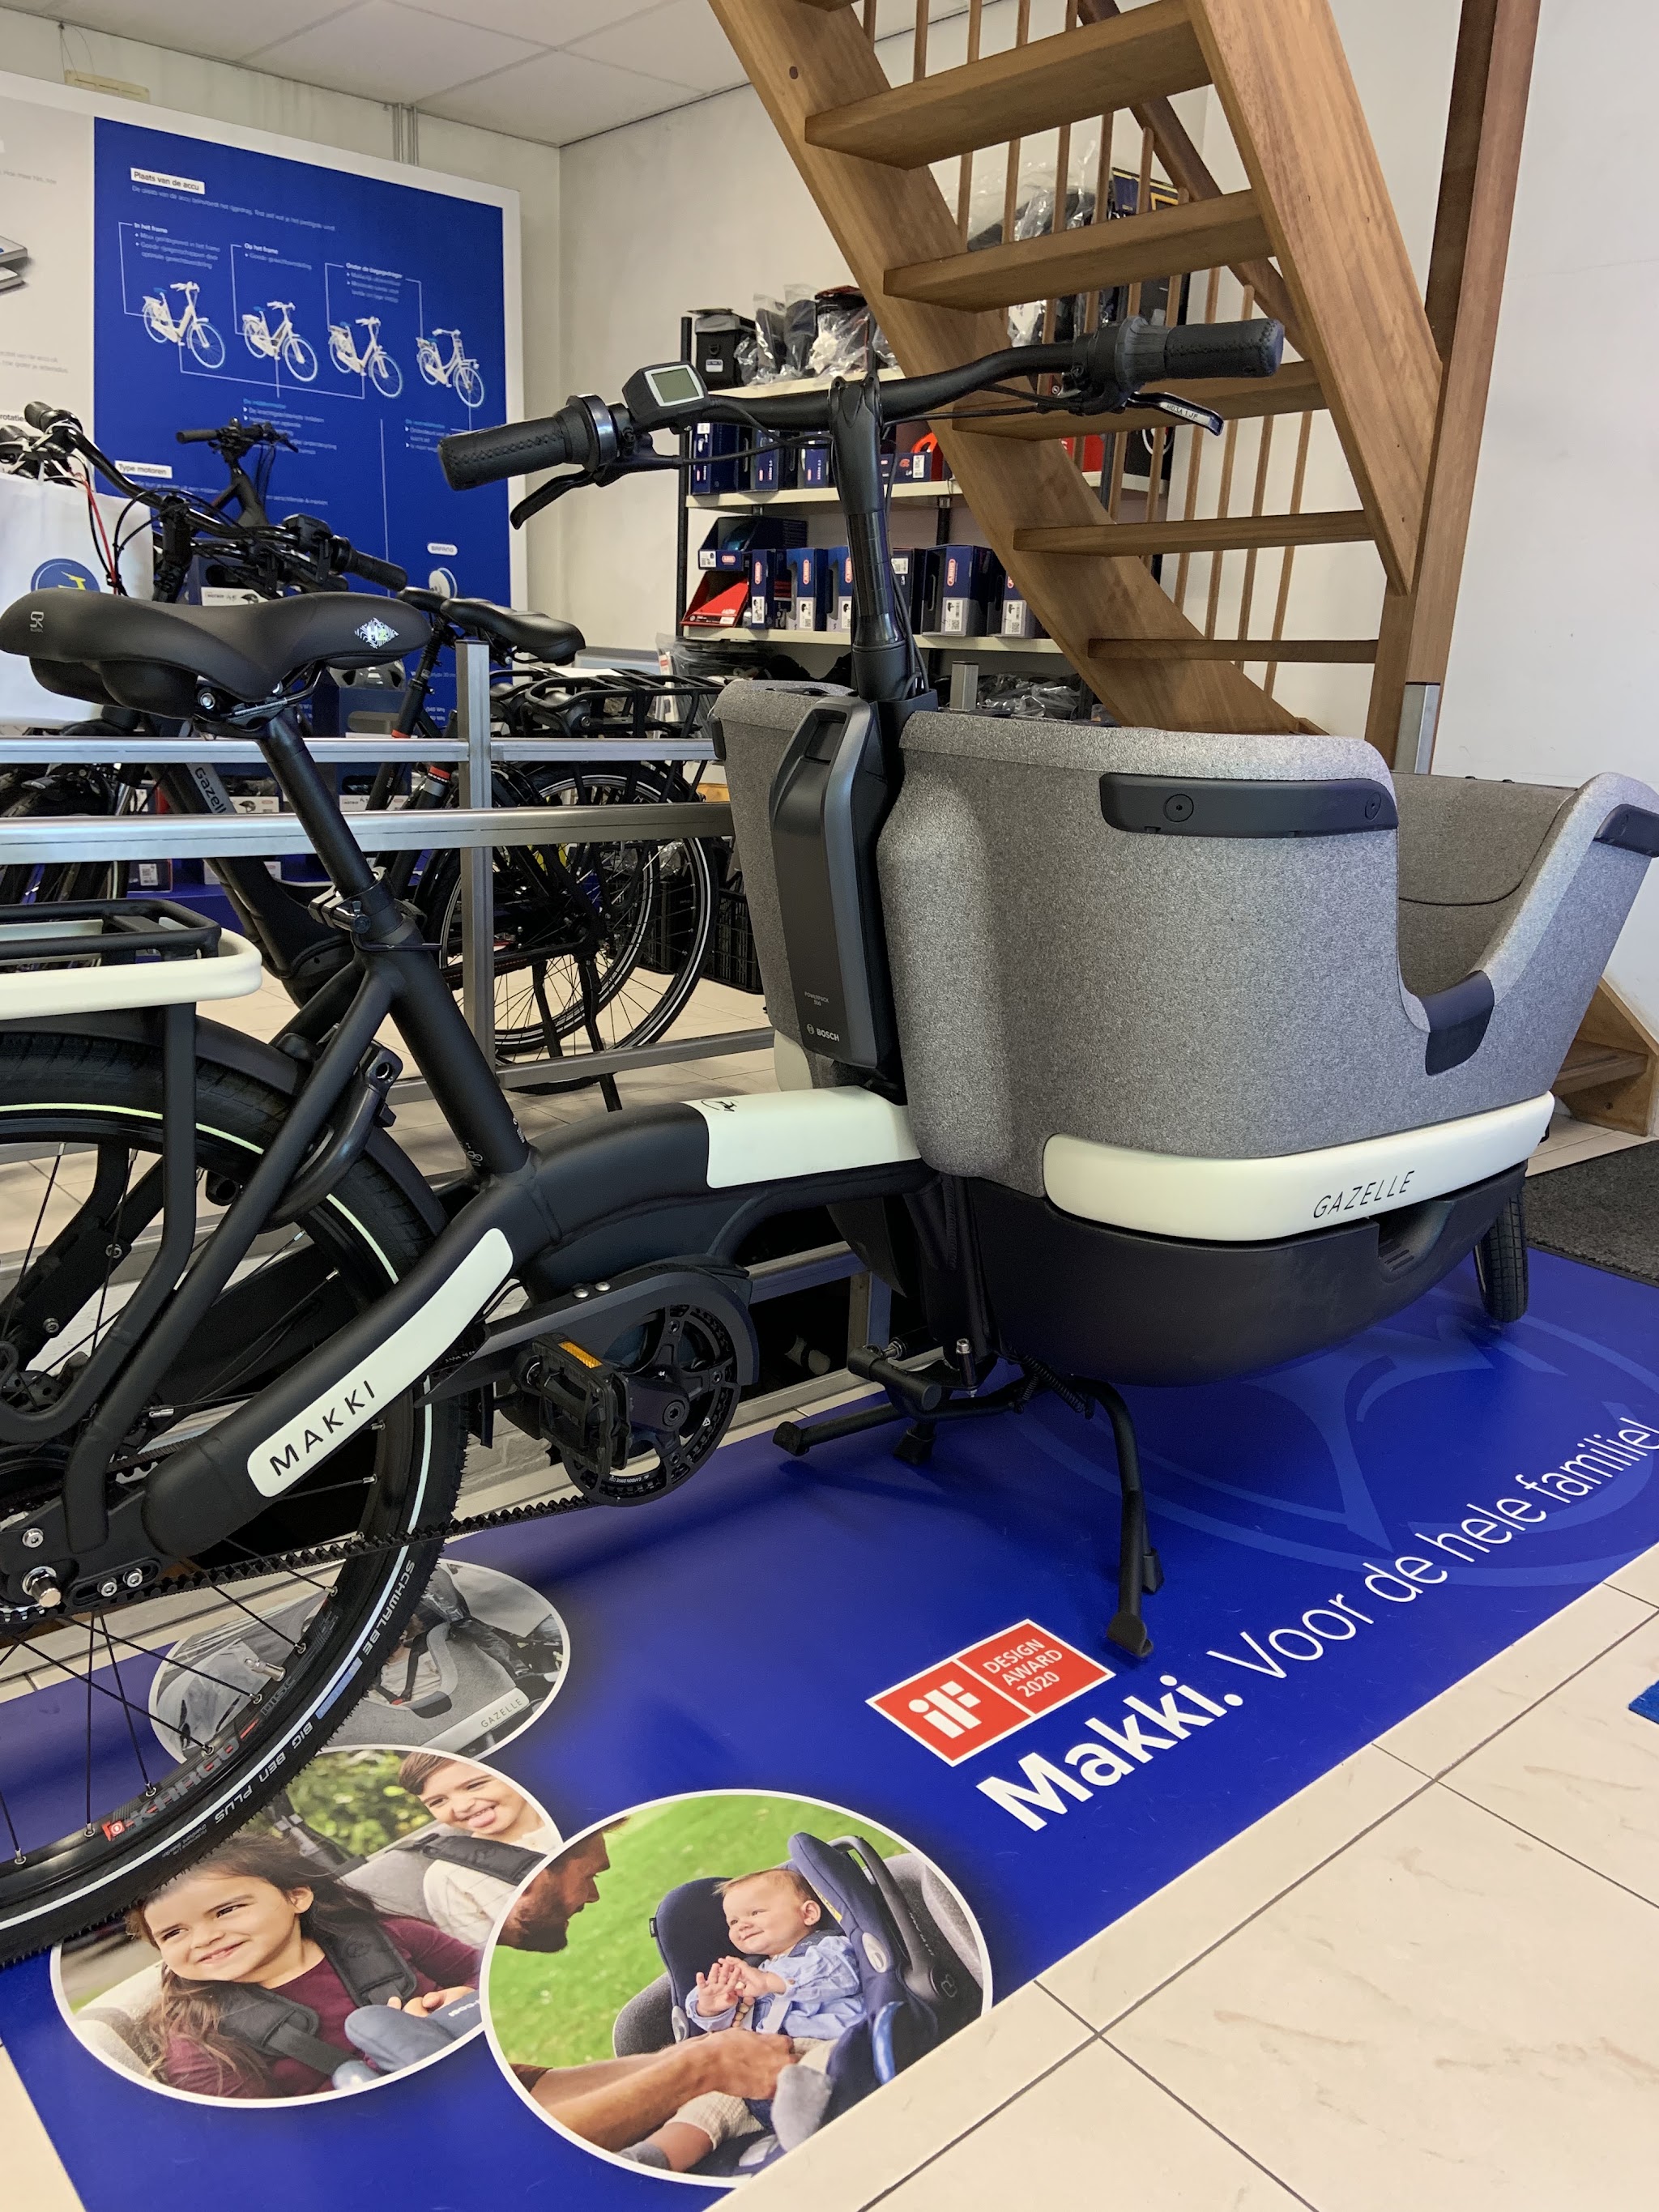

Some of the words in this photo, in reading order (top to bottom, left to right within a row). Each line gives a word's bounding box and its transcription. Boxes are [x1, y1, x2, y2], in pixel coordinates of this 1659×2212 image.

[133, 171, 156, 181] Plaats
[157, 177, 170, 185] van
[172, 179, 181, 187] de
[183, 182, 199, 190] accu
[118, 463, 134, 473] Type
[137, 467, 167, 475] motoren
[194, 766, 227, 814] Gazell
[816, 1027, 840, 1042] BOSCH
[1313, 1170, 1415, 1219] GAZELLE
[269, 1379, 375, 1477] MAKKI
[362, 1559, 416, 1656] SCHWALBE
[975, 1674, 1243, 1832] Makki.
[1205, 1592, 1375, 1679] Voor
[1362, 1555, 1448, 1604] de
[1414, 1496, 1547, 1563] hele
[982, 1638, 1046, 1674] DESIGN
[1001, 1649, 1063, 1686] AWARD
[1016, 1670, 1060, 1698] 2020
[480, 1698, 522, 1728] GAZELLE
[292, 1721, 313, 1750] BIG
[258, 1751, 287, 1783] BEN
[214, 1784, 253, 1824] PLUS
